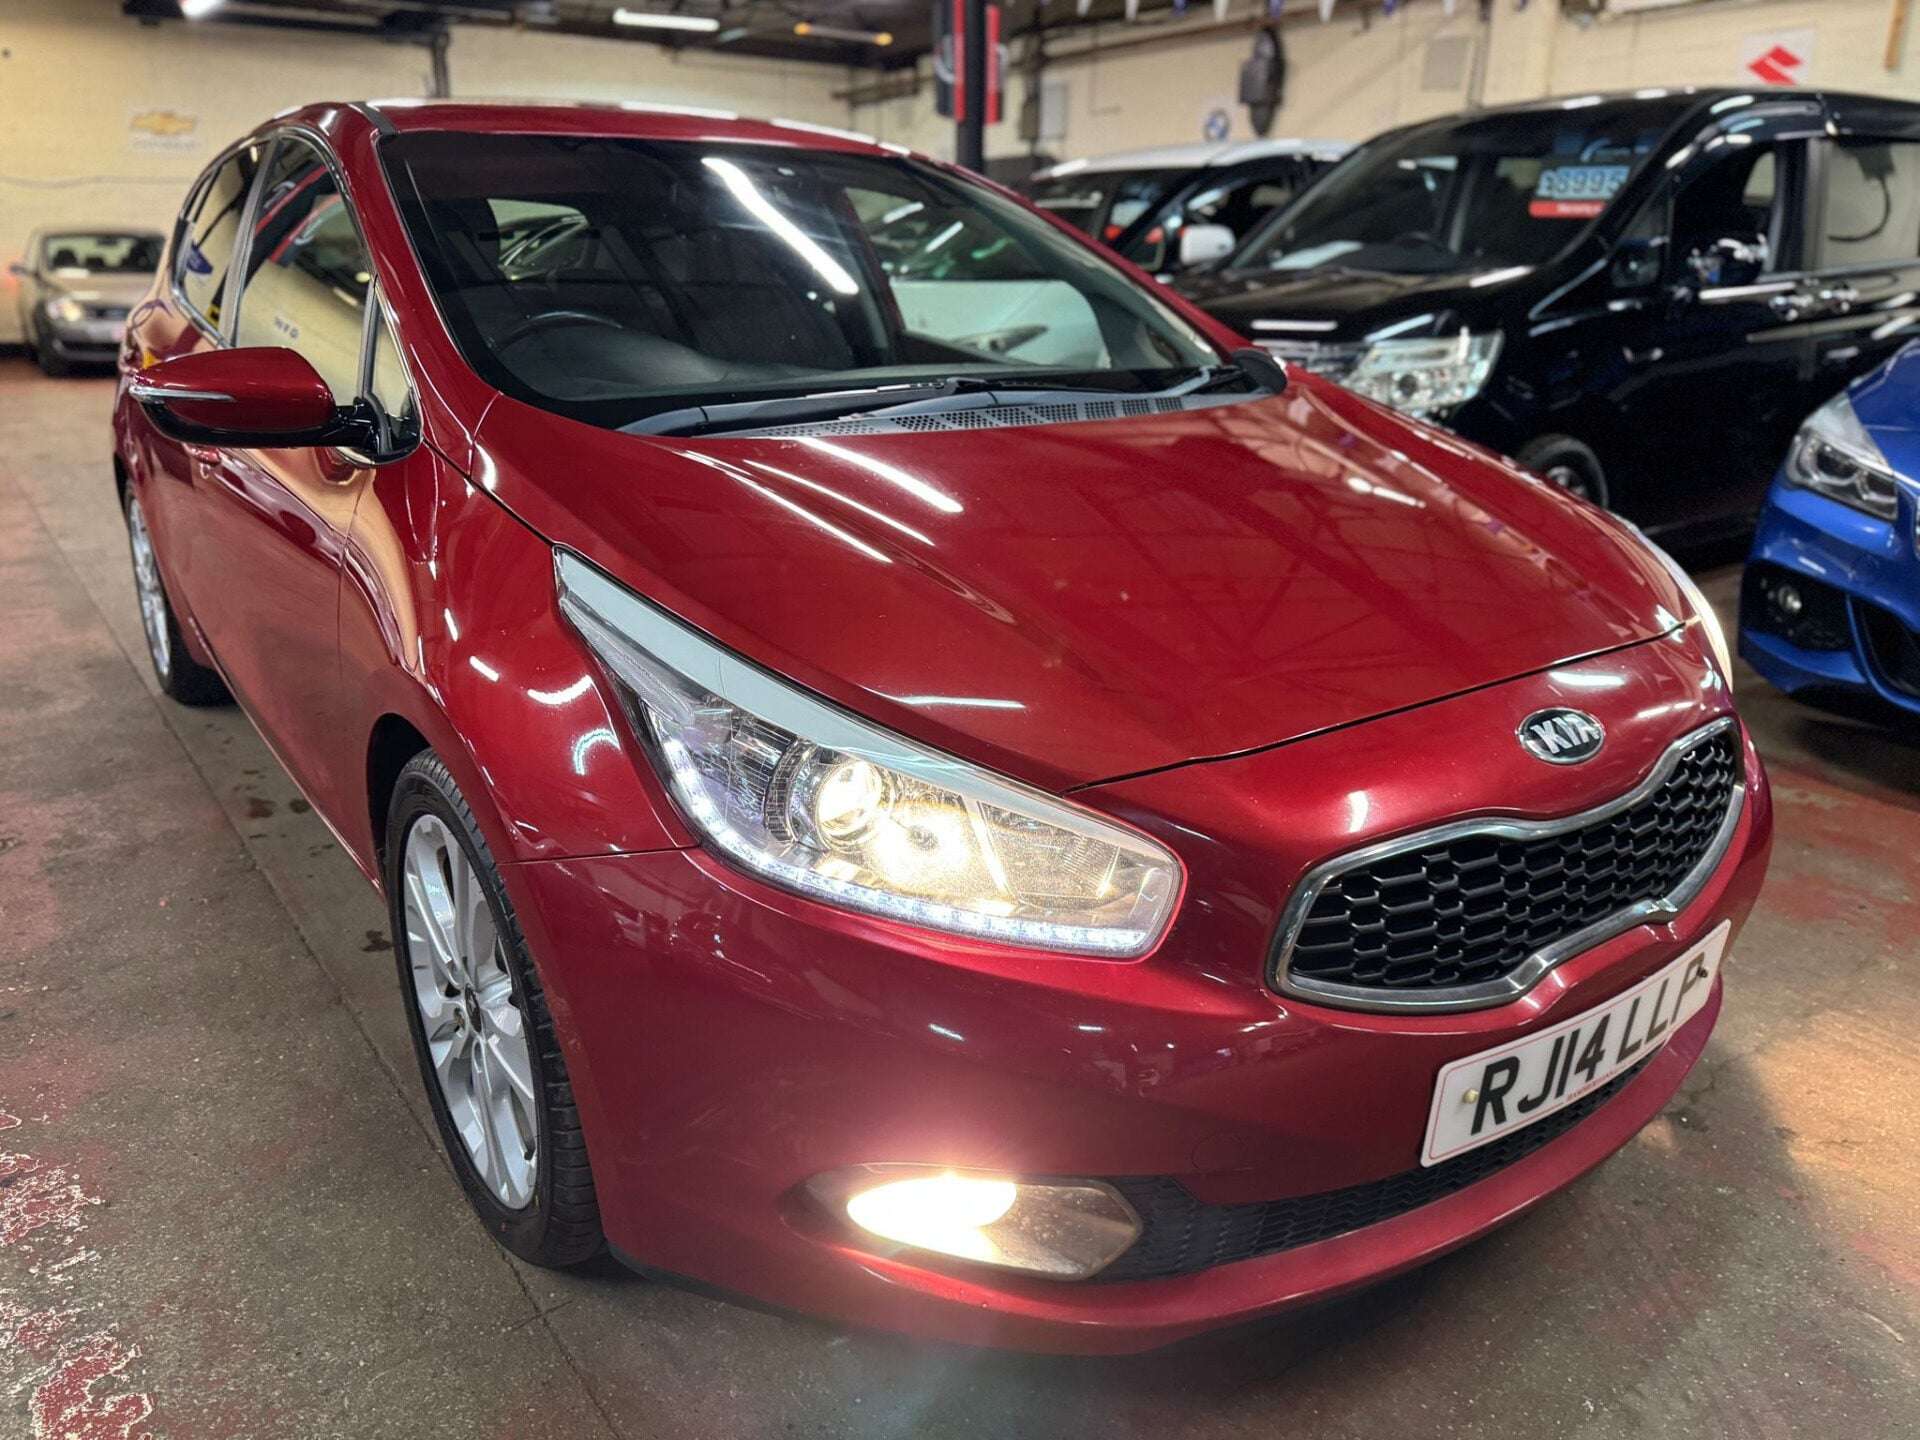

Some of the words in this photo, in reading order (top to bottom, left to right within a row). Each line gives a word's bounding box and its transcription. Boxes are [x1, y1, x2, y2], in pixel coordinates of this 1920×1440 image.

[1530, 713, 1600, 754] KIA
[1470, 1012, 1612, 1136] RJ14
[1616, 951, 1706, 1065] LLP
